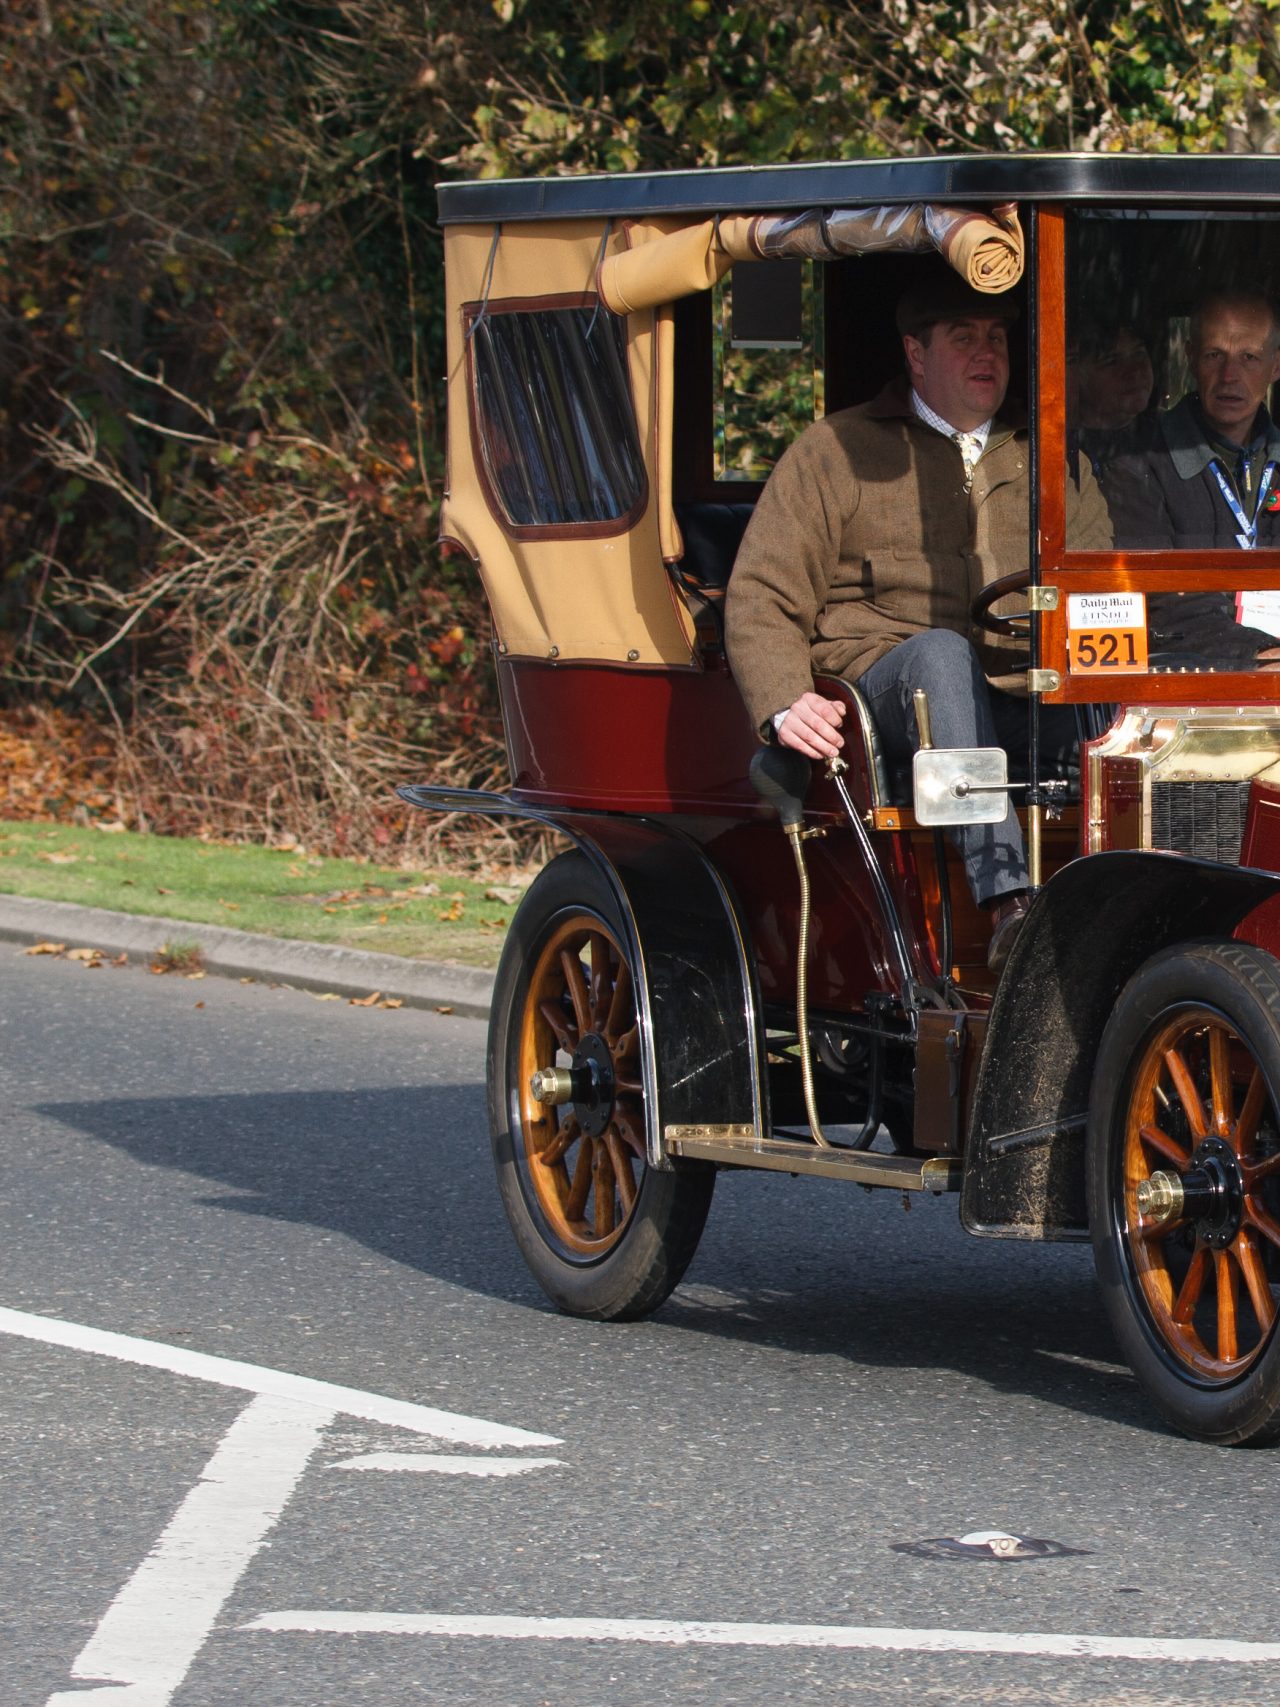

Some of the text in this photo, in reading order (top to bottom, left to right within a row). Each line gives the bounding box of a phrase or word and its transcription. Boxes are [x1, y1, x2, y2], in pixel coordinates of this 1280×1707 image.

[1081, 597, 1133, 610] Daily Mail
[1077, 633, 1138, 668] 521
